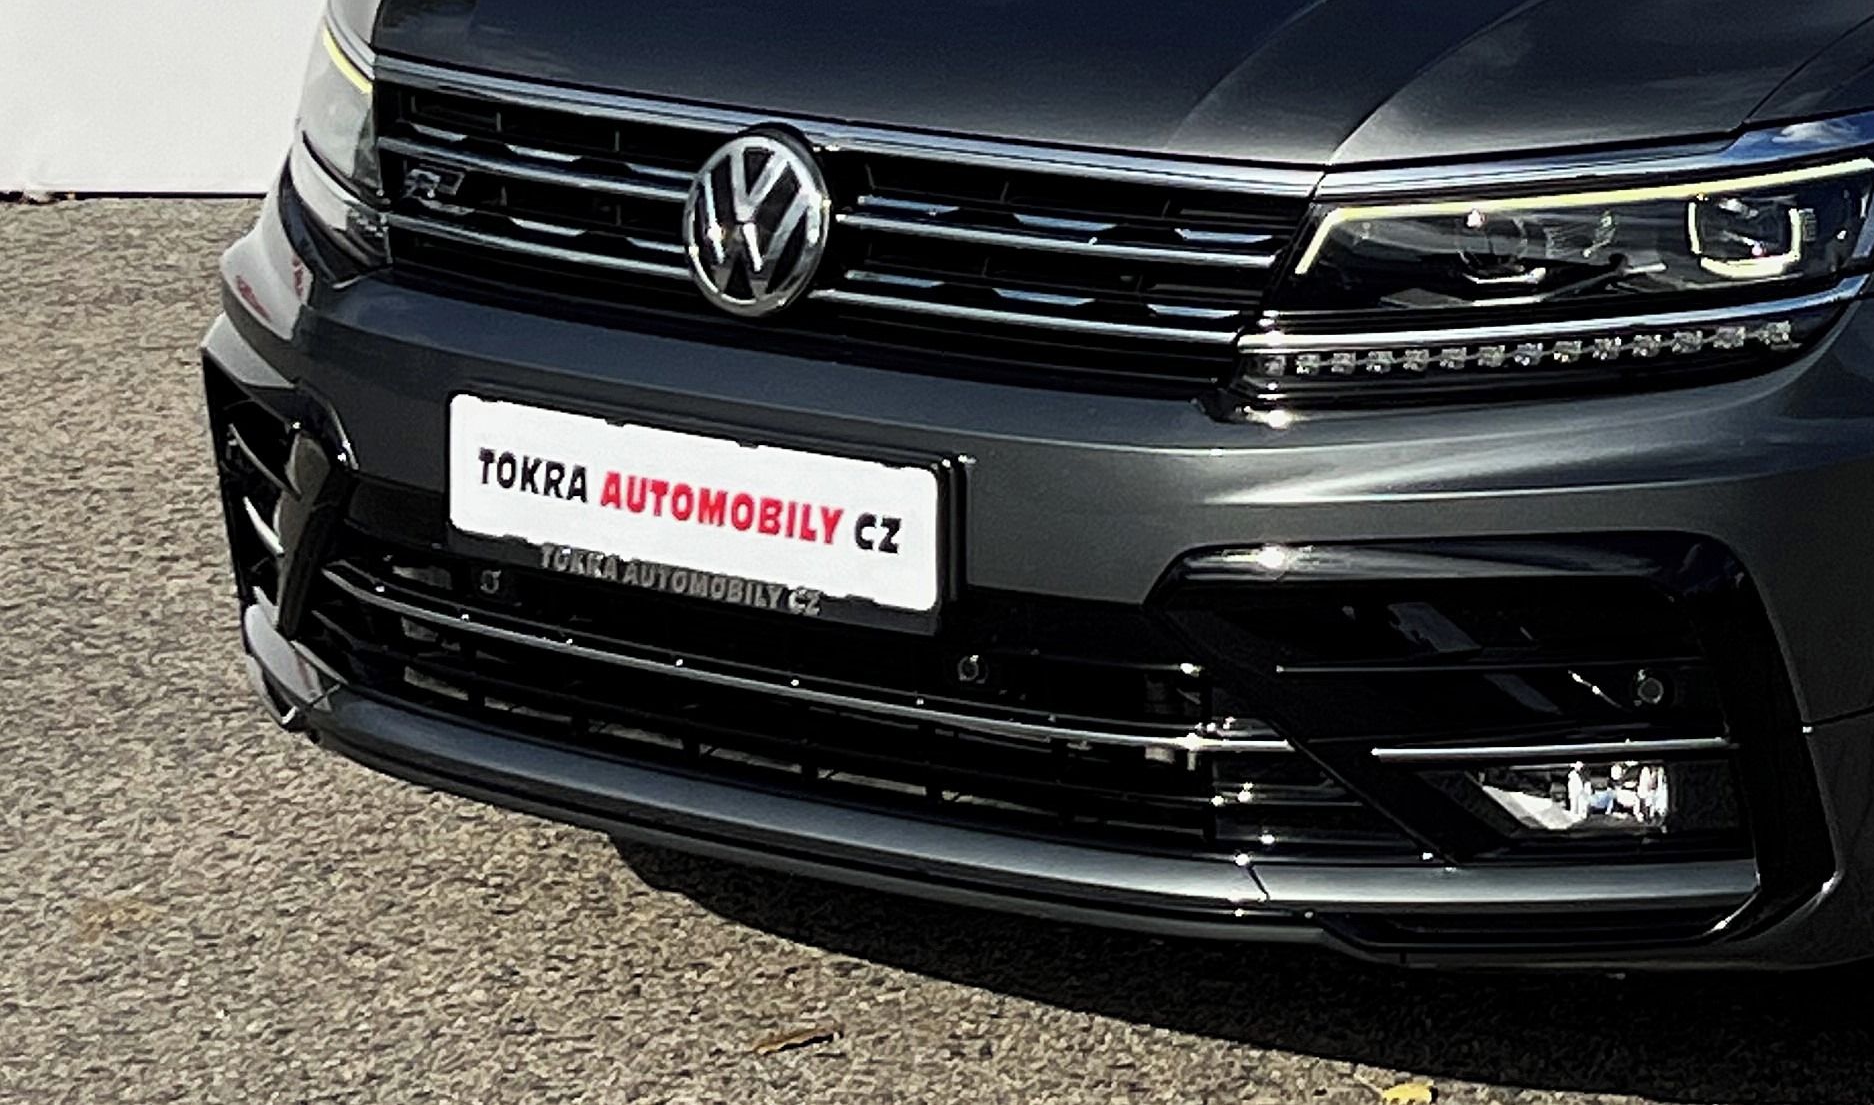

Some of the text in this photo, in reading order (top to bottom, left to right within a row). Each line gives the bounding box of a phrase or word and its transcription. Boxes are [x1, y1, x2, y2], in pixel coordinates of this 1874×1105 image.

[478, 447, 902, 554] TOKRA AUTOMOBILY CZ
[622, 559, 786, 609] AUTOMOBILY
